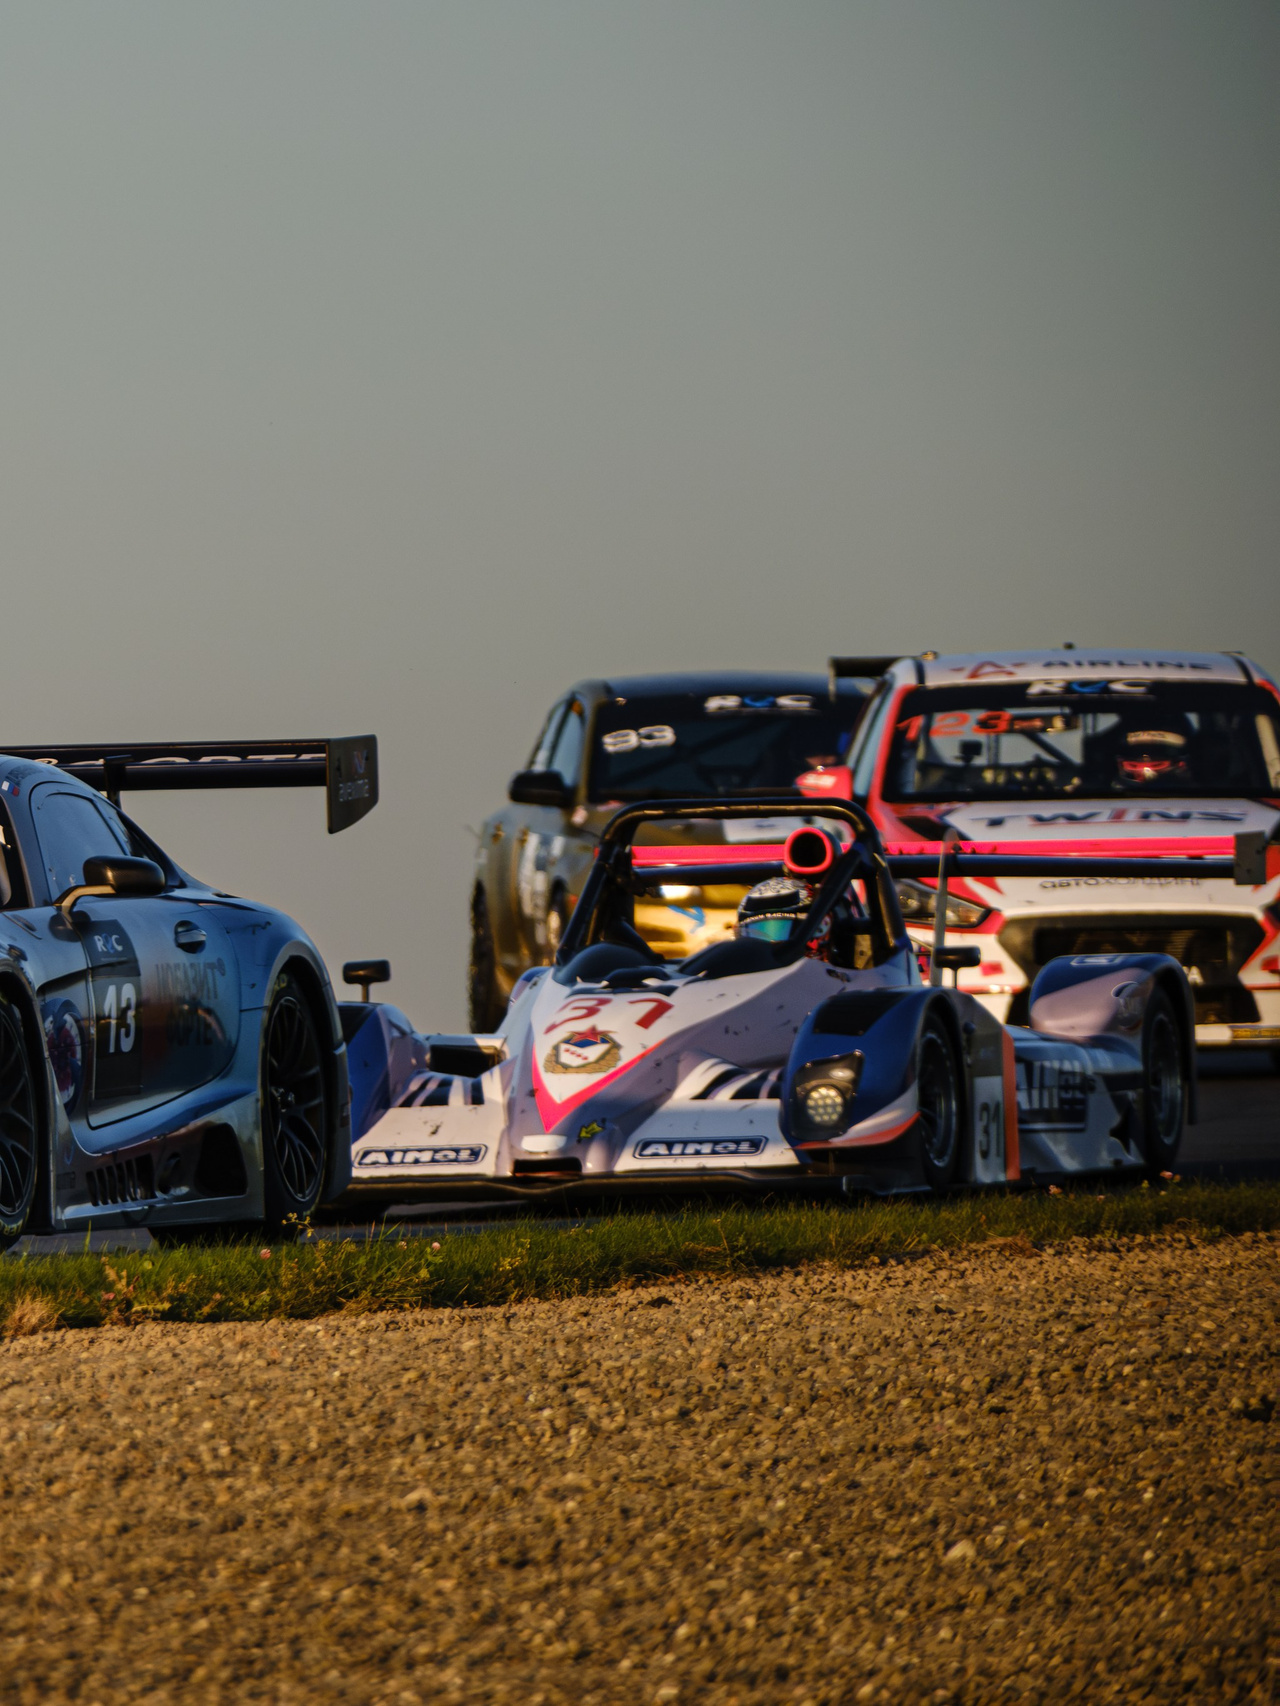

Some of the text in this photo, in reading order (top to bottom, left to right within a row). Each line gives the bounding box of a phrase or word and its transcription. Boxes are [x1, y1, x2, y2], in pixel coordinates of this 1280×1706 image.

[1042, 659, 1214, 671] AIRLINE
[601, 724, 677, 753] 93
[895, 710, 1014, 742] 123
[103, 982, 137, 1054] 13
[543, 997, 675, 1035] 31
[979, 1101, 1002, 1161] 31
[359, 1148, 477, 1165] AIMOL
[640, 1140, 757, 1156] AIMOL
